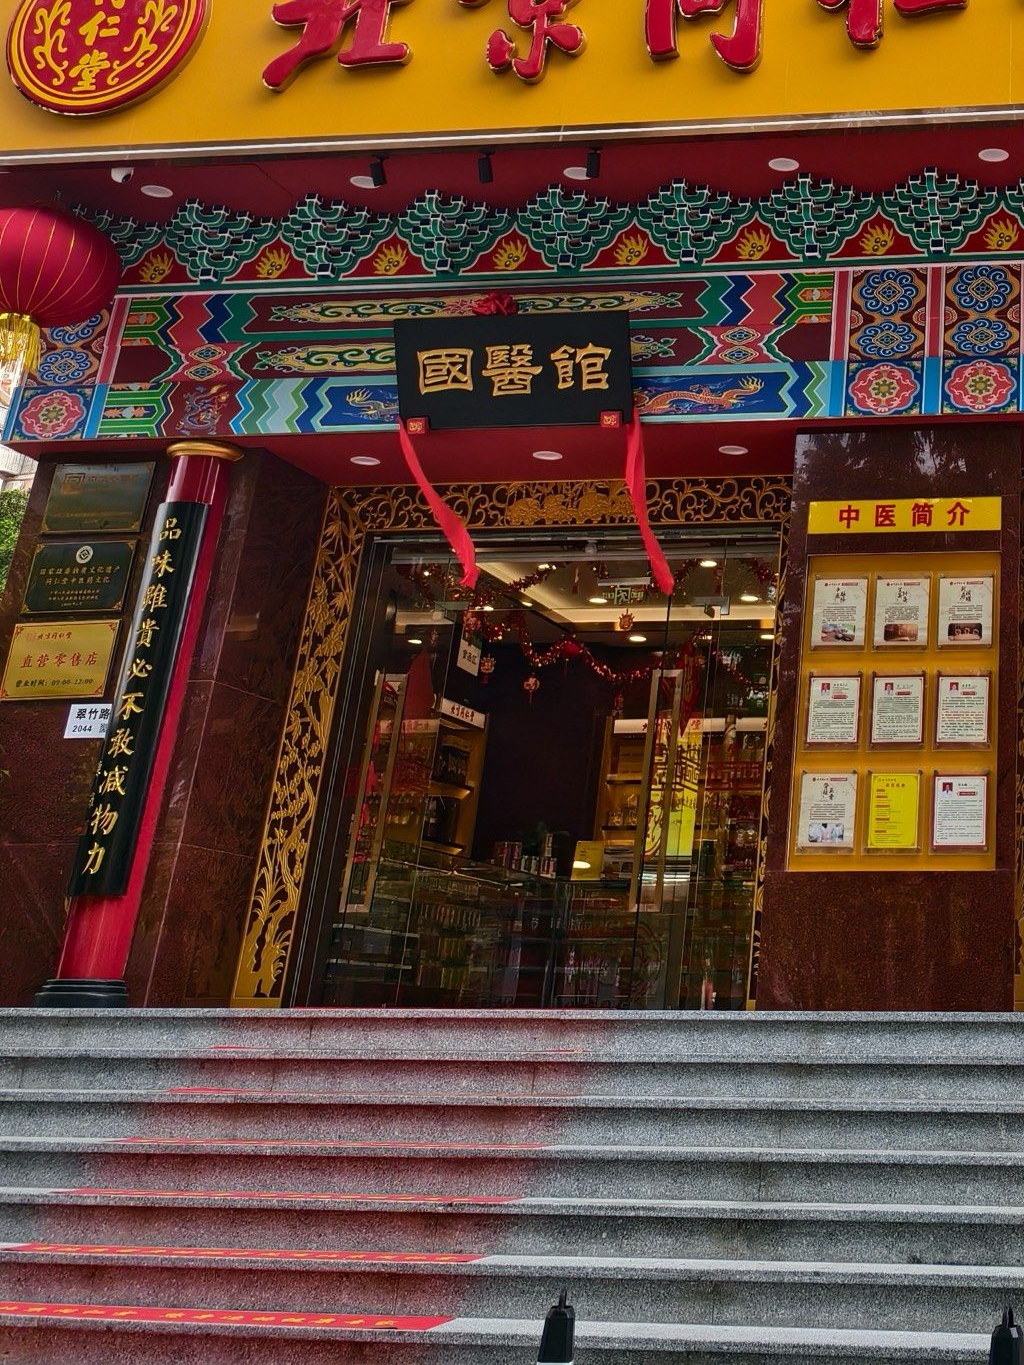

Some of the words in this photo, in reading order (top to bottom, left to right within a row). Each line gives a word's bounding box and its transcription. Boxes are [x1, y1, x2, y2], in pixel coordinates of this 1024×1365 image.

[417, 342, 612, 397] 國醫館
[838, 502, 970, 529] 中医简介
[20, 652, 98, 669] 直营零售店
[76, 708, 110, 720] 翠竹路
